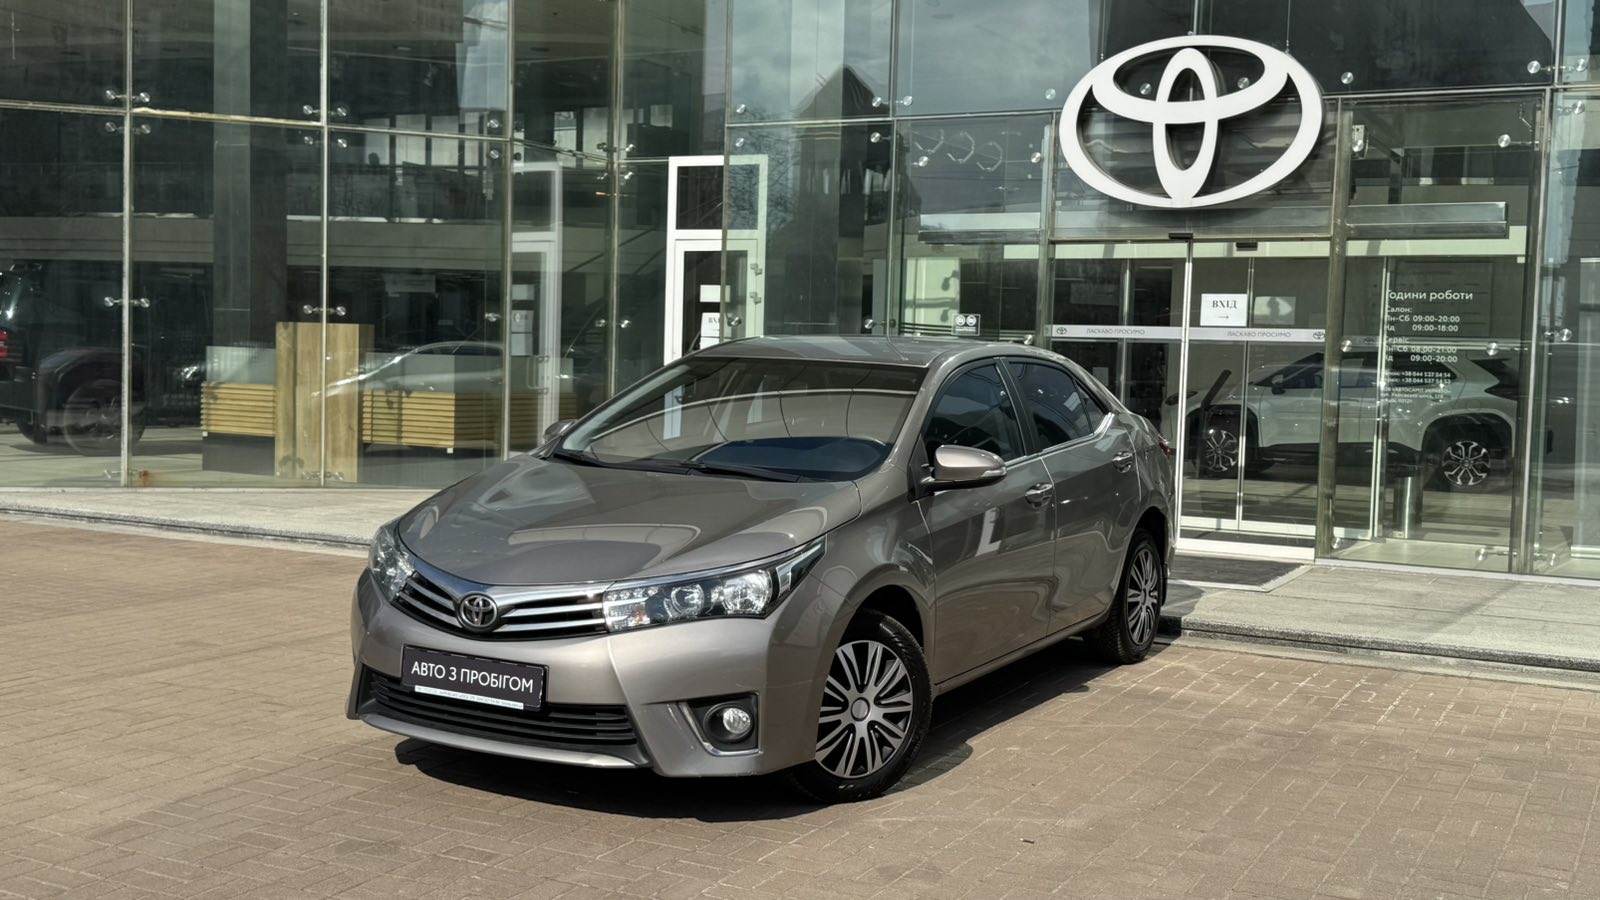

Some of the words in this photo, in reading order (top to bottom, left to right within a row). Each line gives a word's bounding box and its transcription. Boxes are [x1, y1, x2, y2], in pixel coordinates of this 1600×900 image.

[1429, 290, 1473, 301] роботи
[1212, 300, 1237, 309] ВХІД
[1412, 324, 1459, 332] 09:00-18:00
[1410, 355, 1458, 363] 09:00-20:00
[411, 661, 446, 679] АВТО
[460, 668, 534, 693] ПРОБІГОМ
